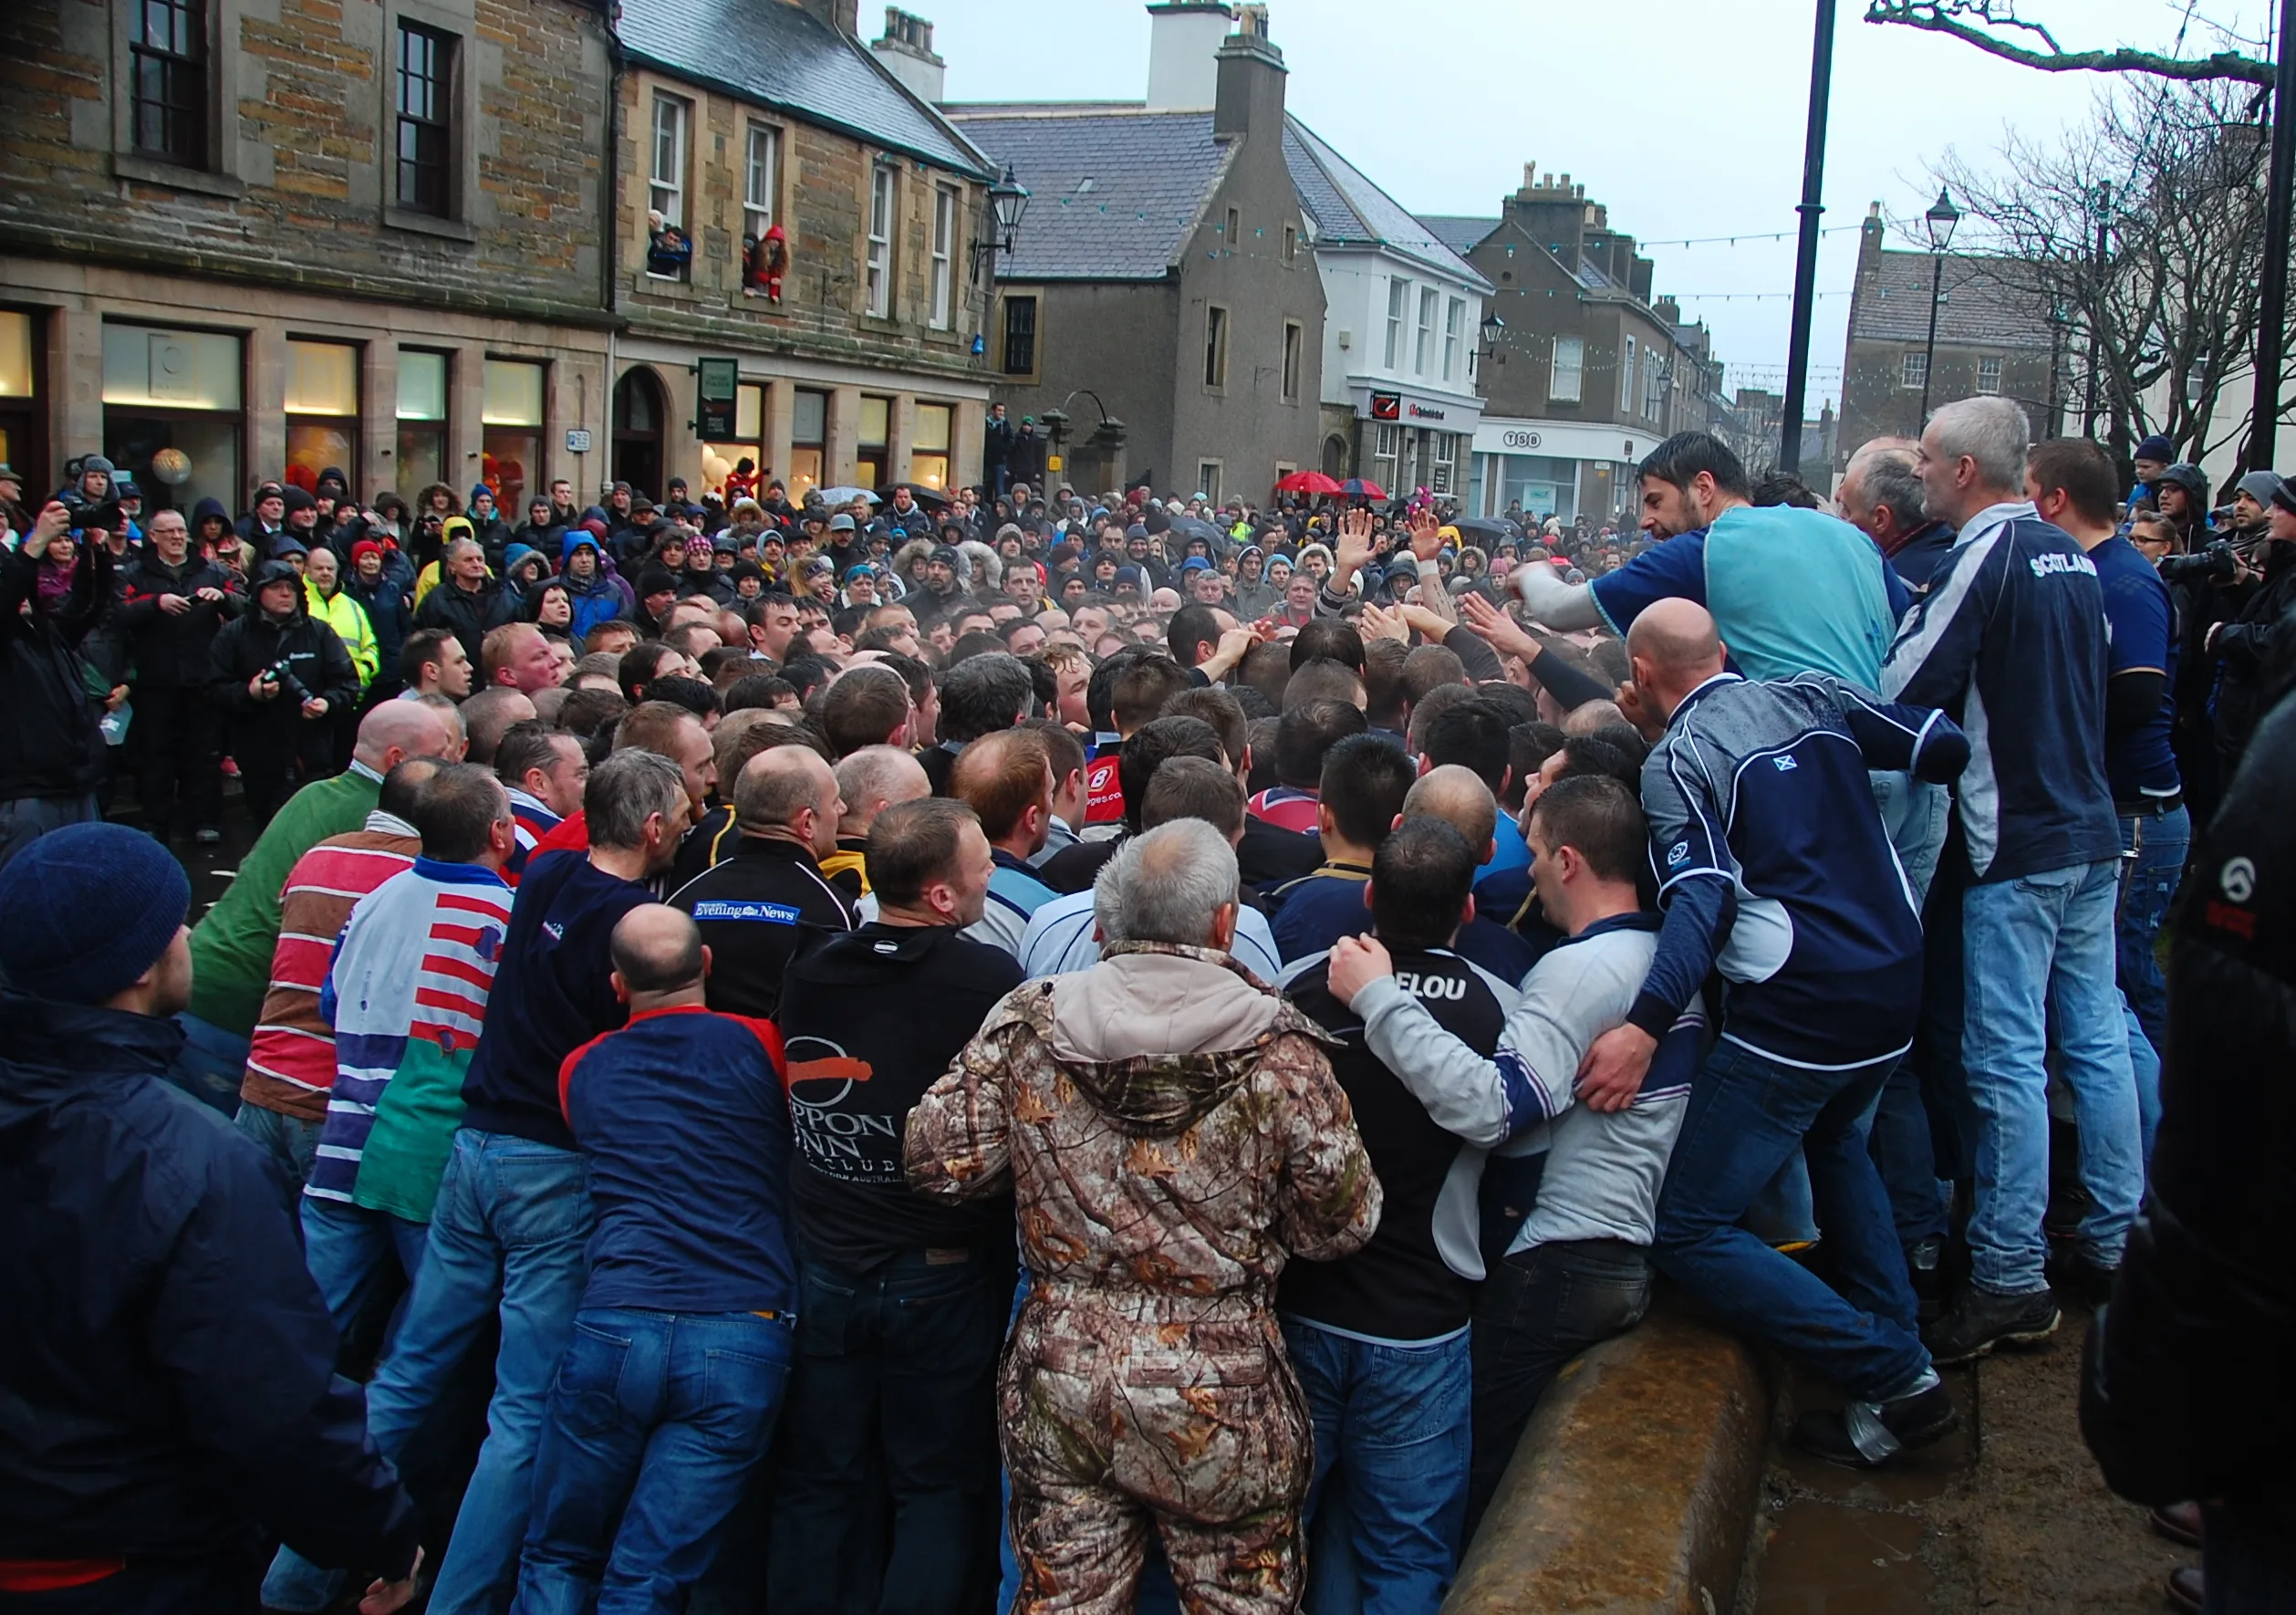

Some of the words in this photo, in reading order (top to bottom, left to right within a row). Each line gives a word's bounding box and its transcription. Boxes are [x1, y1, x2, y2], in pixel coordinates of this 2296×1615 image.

[1506, 432, 1539, 446] TSB
[1086, 792, 1123, 807] ges.co
[695, 903, 742, 919] Evening
[760, 905, 795, 921] News
[824, 1158, 896, 1172] CLUB
